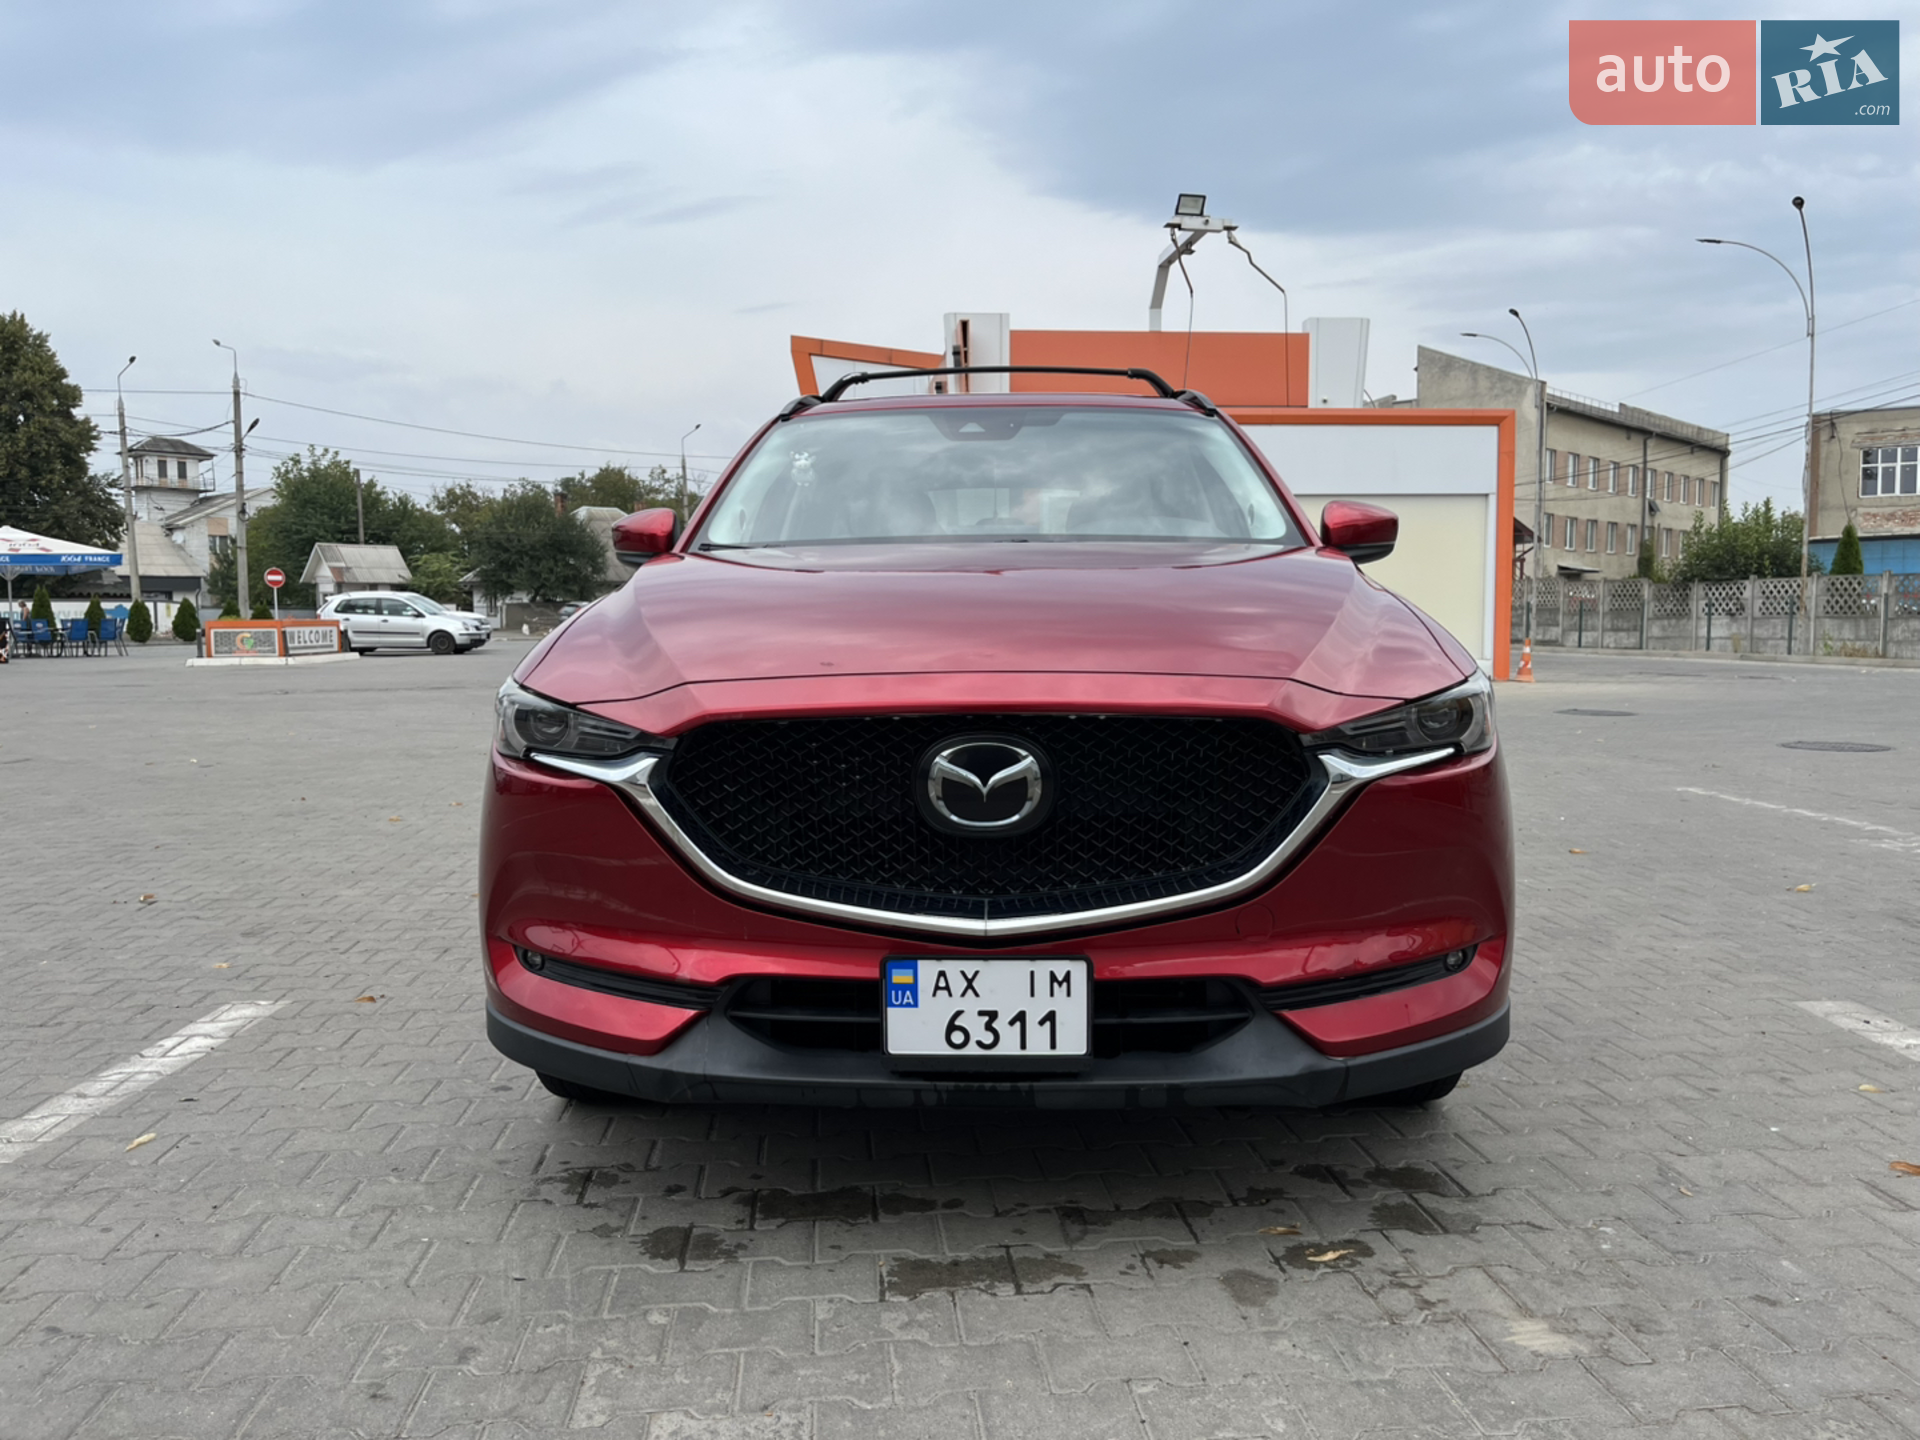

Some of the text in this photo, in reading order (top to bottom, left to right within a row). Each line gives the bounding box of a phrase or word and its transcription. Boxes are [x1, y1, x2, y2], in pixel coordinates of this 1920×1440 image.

[287, 628, 334, 645] WELCOME
[932, 969, 1072, 998] AX IM
[891, 990, 914, 1005] UA
[944, 1009, 1057, 1051] 6311
